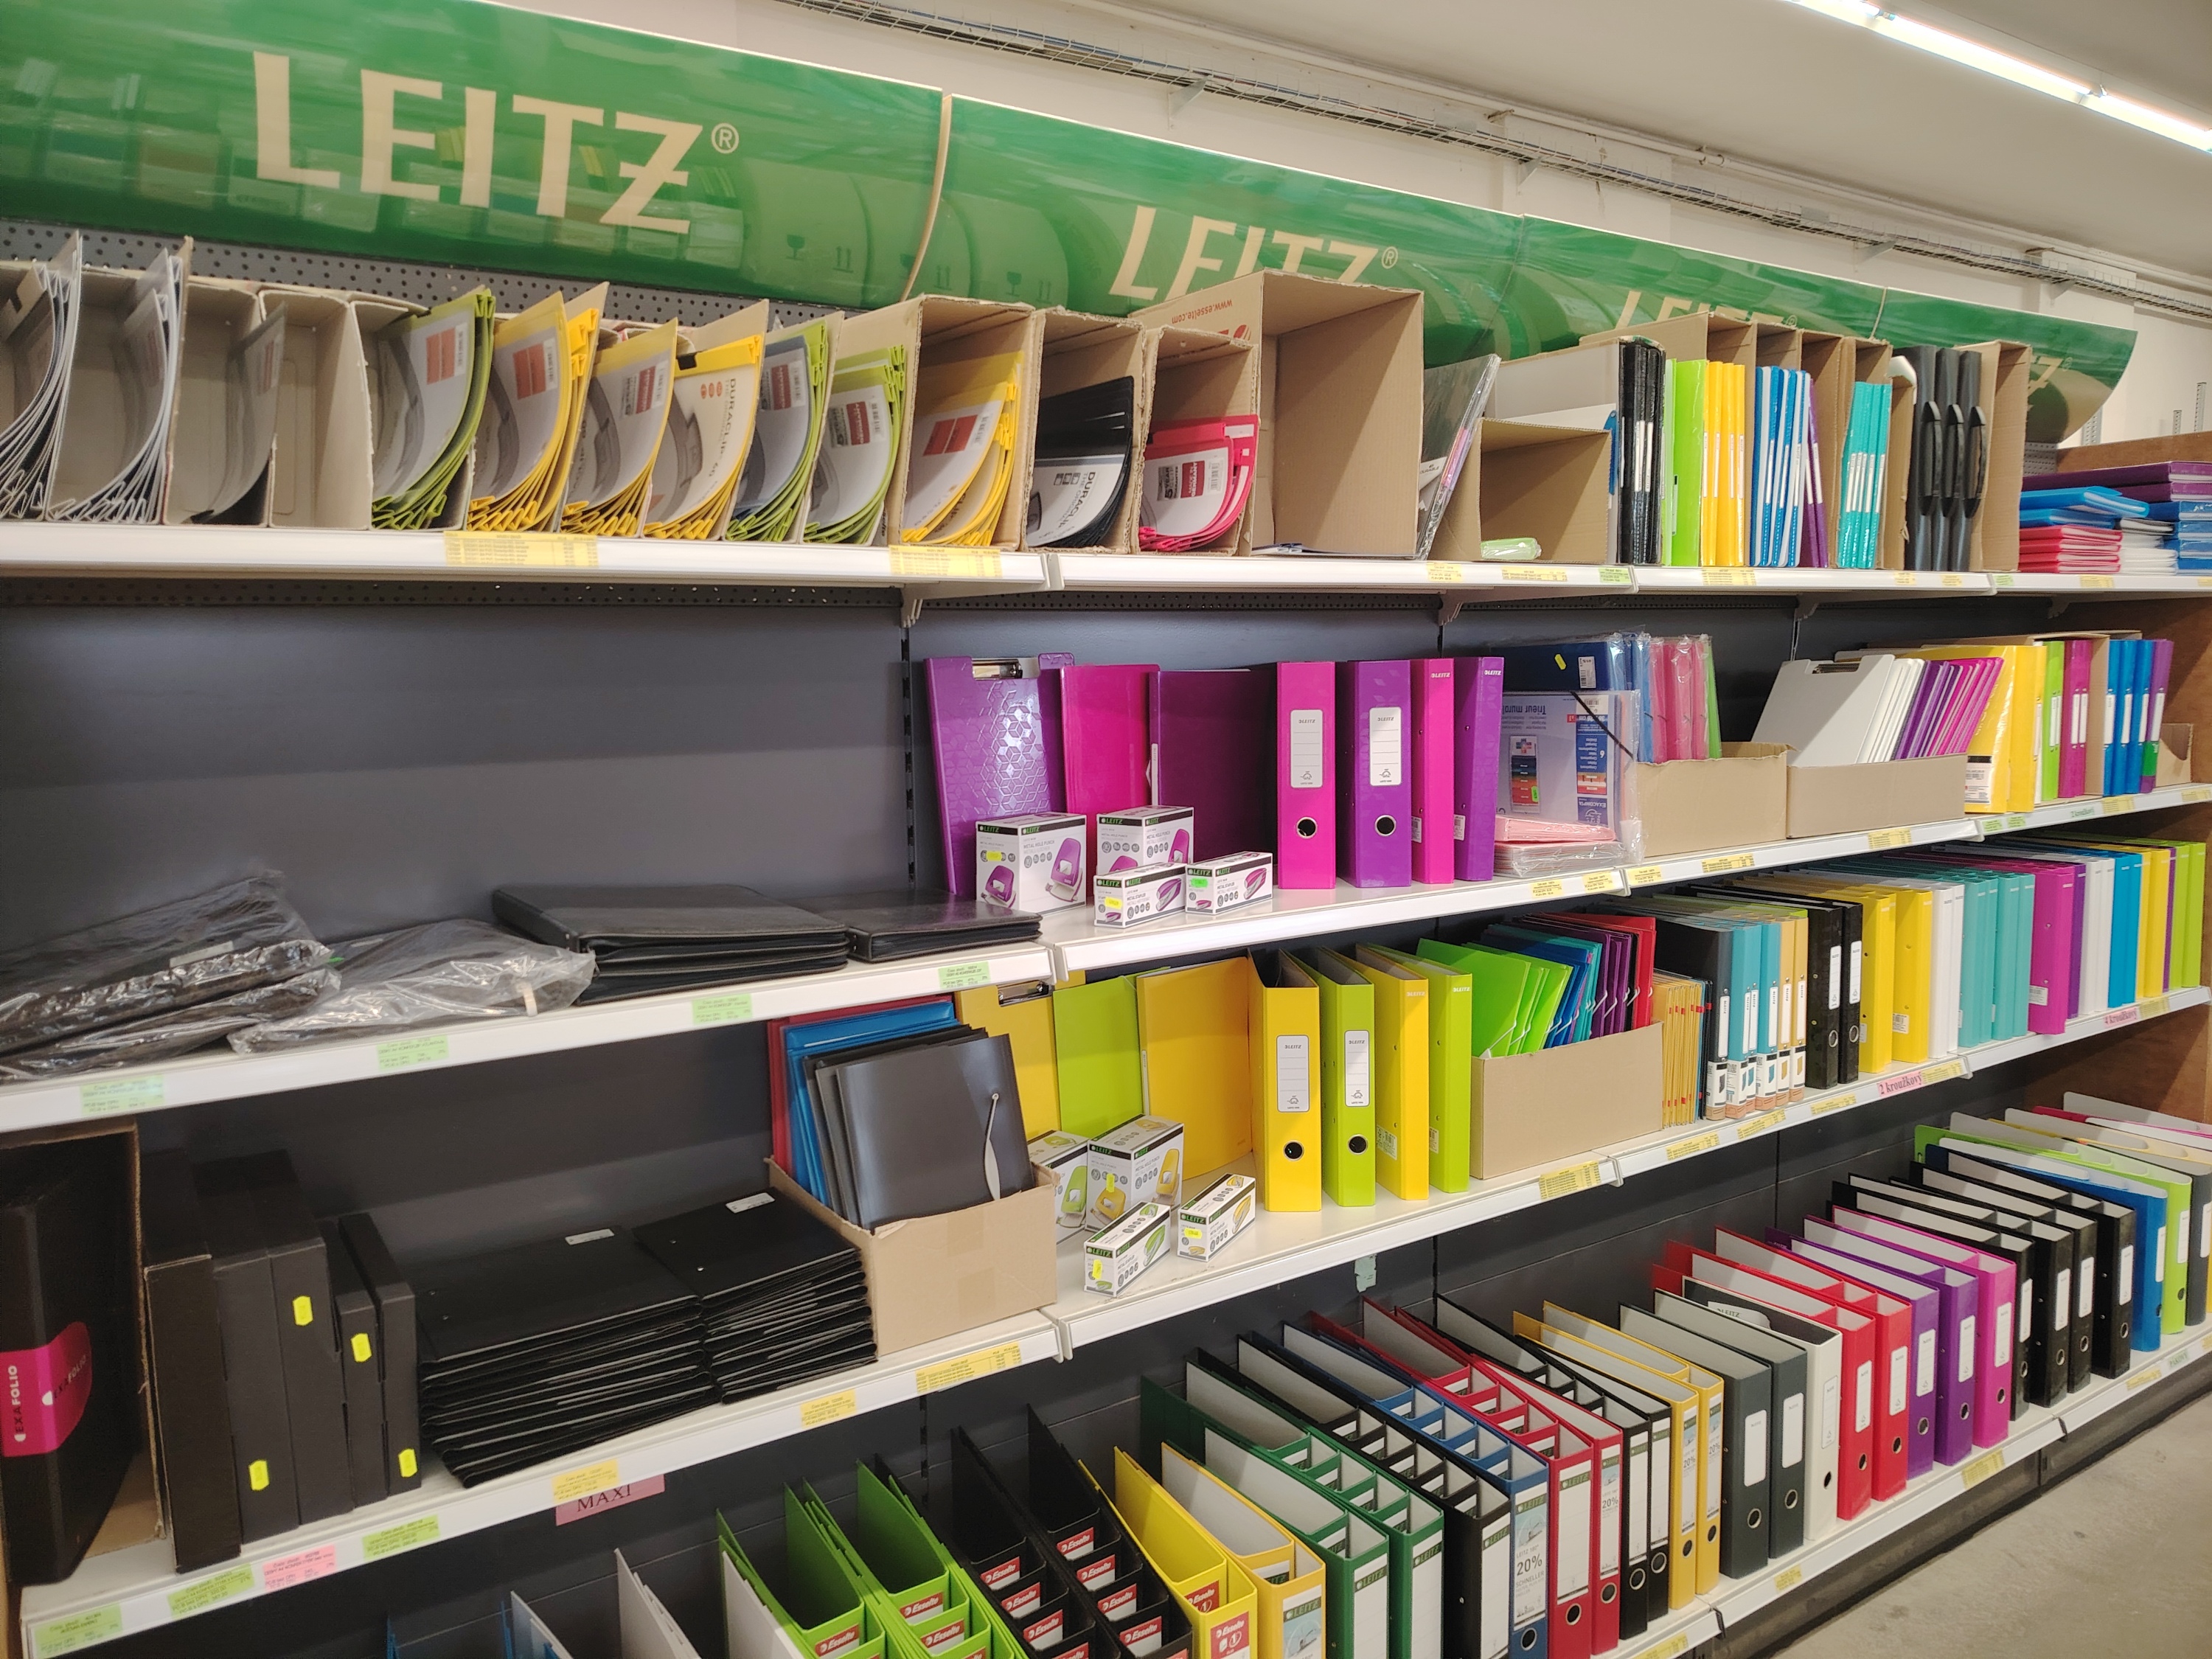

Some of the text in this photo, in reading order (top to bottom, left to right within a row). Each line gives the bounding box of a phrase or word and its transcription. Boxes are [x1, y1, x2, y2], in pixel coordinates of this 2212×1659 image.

[1172, 299, 1232, 324] www.esselte.com
[720, 378, 736, 454] DURACLIP
[1058, 472, 1096, 528] DURACLIP
[1526, 705, 1546, 715] Trieur
[1026, 826, 1040, 834] LEITZ
[1219, 868, 1231, 876] LEITZ
[1130, 878, 1141, 886] LEITZ
[1879, 1071, 1921, 1094] 2 kroužkový
[1095, 1147, 1112, 1155] LEITZ
[1138, 1147, 1148, 1158] LEITZ
[1186, 1215, 1205, 1224] LEITZ
[1092, 1248, 1112, 1257] LEITZ
[1722, 1309, 1740, 1318] LEITZ
[8, 1366, 24, 1432] EXAFOLIO
[1683, 1457, 1696, 1468] 20%
[1568, 1472, 1589, 1487] LEITZ
[577, 1484, 632, 1512] MAXI
[1524, 1495, 1545, 1510] LEITZ
[1602, 1496, 1618, 1509] 20%
[1068, 1534, 1090, 1549] Esselte
[1489, 1526, 1509, 1544] LEITZ
[1420, 1542, 1441, 1562] LEITZ
[993, 1564, 1016, 1580] Esselte
[1088, 1562, 1111, 1578] Esselte
[1517, 1554, 1543, 1576] 20%
[1364, 1568, 1386, 1586] LEITZ
[1012, 1590, 1037, 1607] Esselte
[1108, 1591, 1133, 1607] Esselte
[1193, 1588, 1215, 1604] Esselte
[911, 1596, 939, 1613] Esselte
[1293, 1599, 1321, 1616] LEITZ
[933, 1625, 960, 1643] Esselte
[1034, 1618, 1060, 1635] Esselte
[1132, 1622, 1158, 1640] Esselte
[1222, 1619, 1245, 1635] Esselte
[827, 1630, 855, 1650] Esselte
